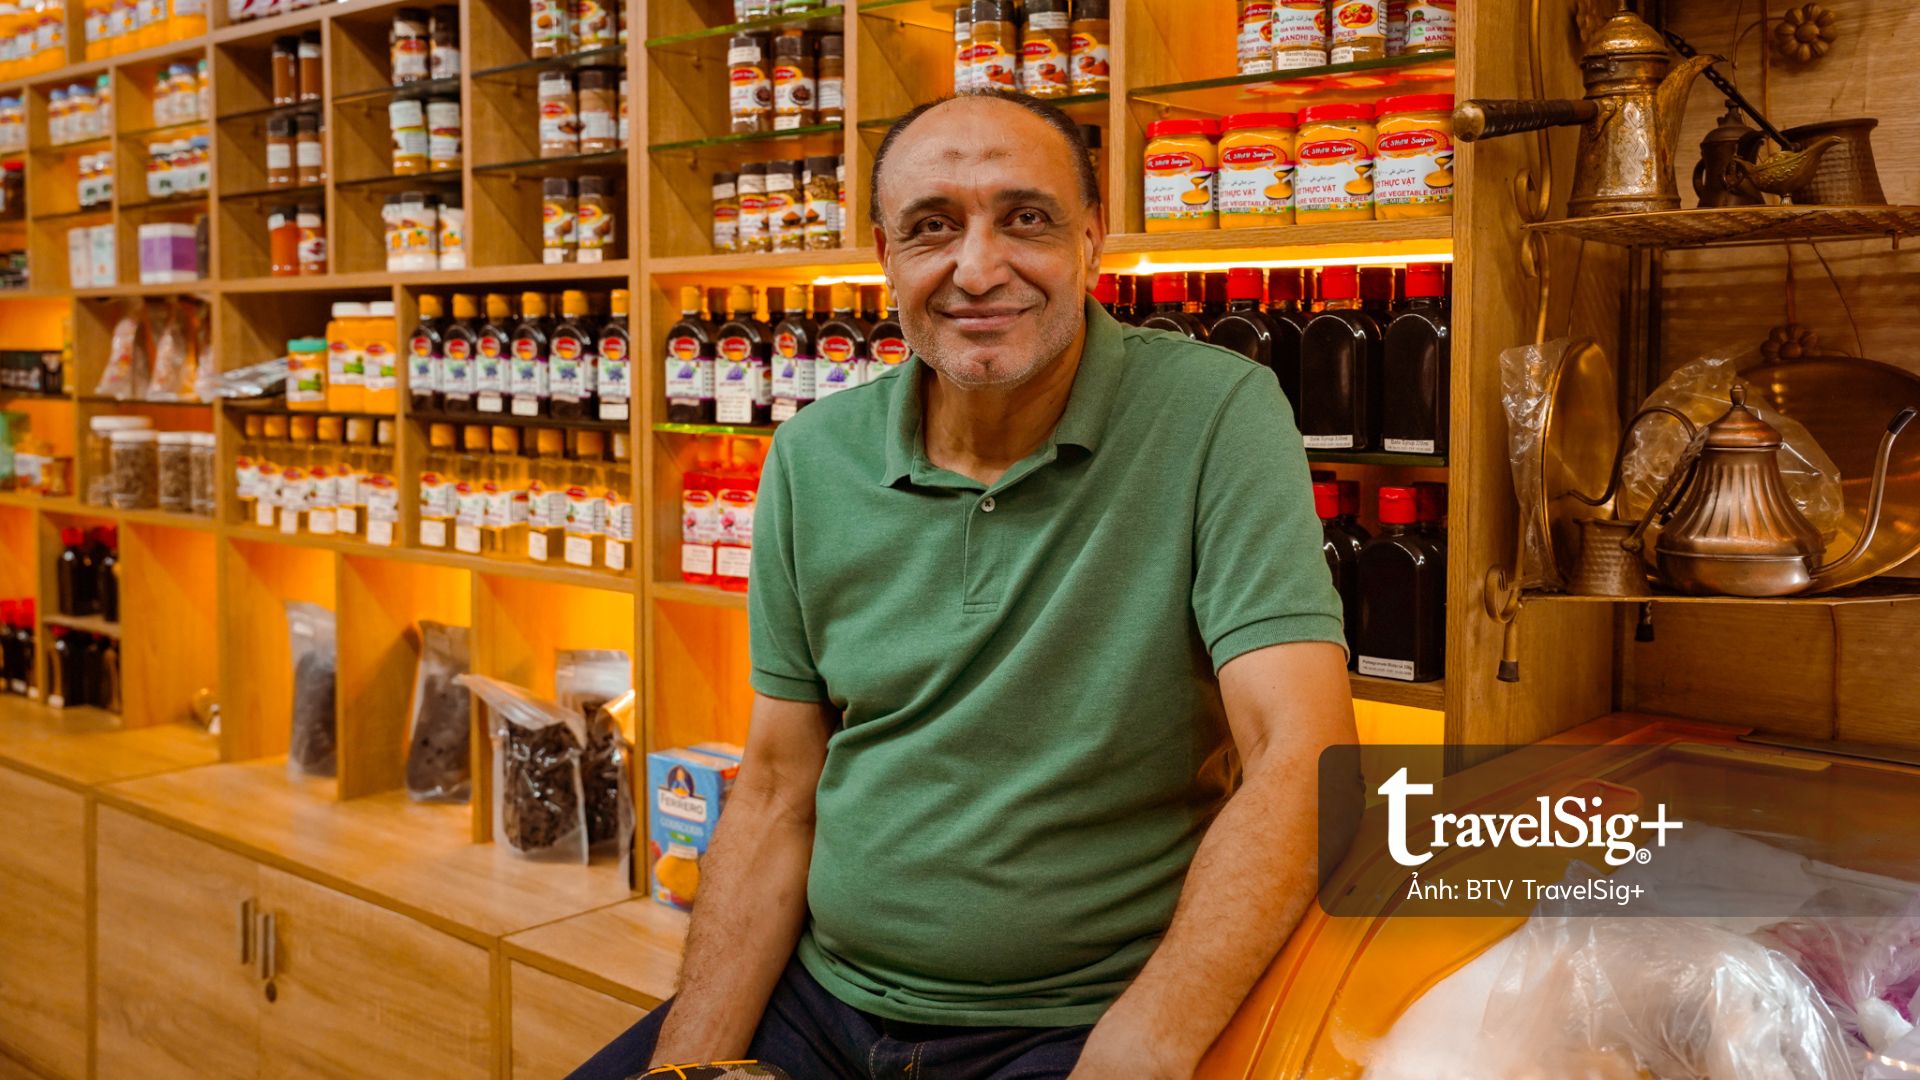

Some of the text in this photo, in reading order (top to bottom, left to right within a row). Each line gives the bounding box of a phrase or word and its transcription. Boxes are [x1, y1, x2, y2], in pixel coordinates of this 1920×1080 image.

[1280, 34, 1308, 43] MANDHI
[1381, 179, 1400, 188] THỰC
[1401, 177, 1416, 187] VẬT
[1389, 189, 1428, 197] VEGETABLE
[1430, 187, 1449, 195] GHEE
[1350, 194, 1369, 202] GHEE
[661, 791, 704, 816] FERRERO
